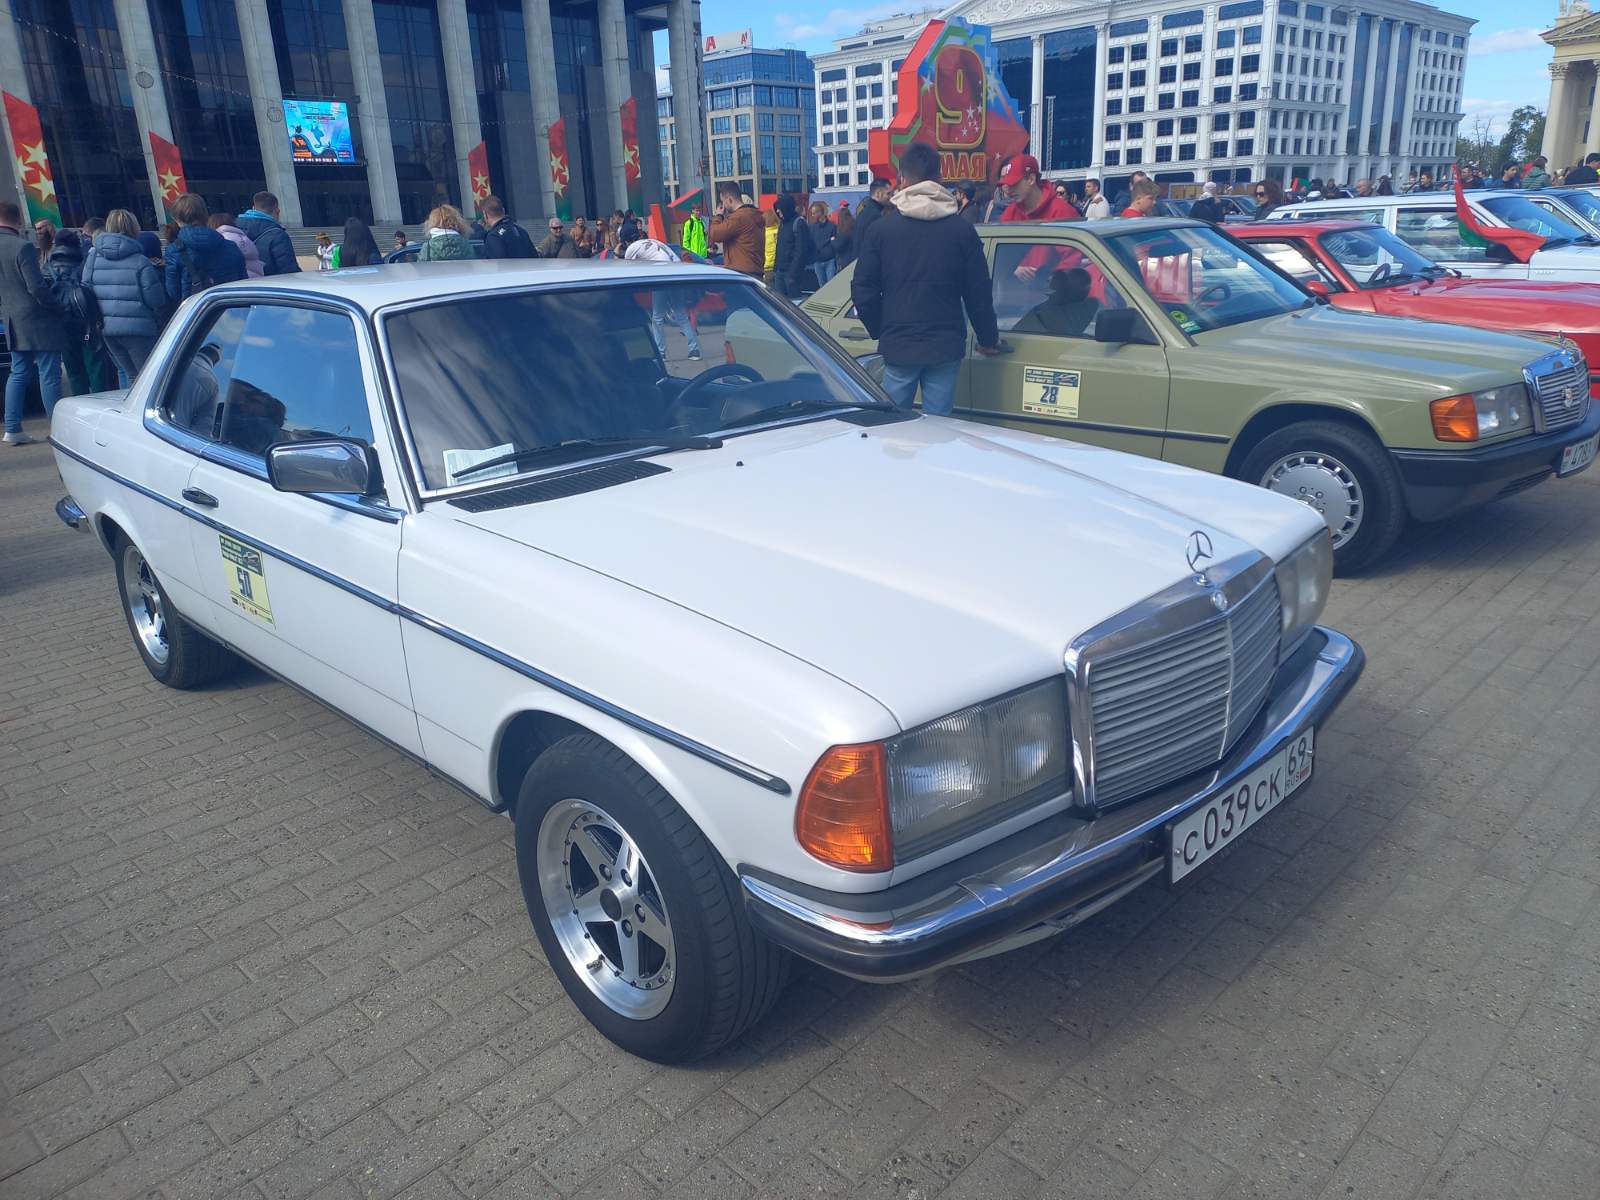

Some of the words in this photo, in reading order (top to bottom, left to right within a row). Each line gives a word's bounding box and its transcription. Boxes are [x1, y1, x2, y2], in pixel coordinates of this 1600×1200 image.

[935, 44, 987, 149] 9
[1040, 385, 1059, 404] 28
[1287, 737, 1307, 776] 69
